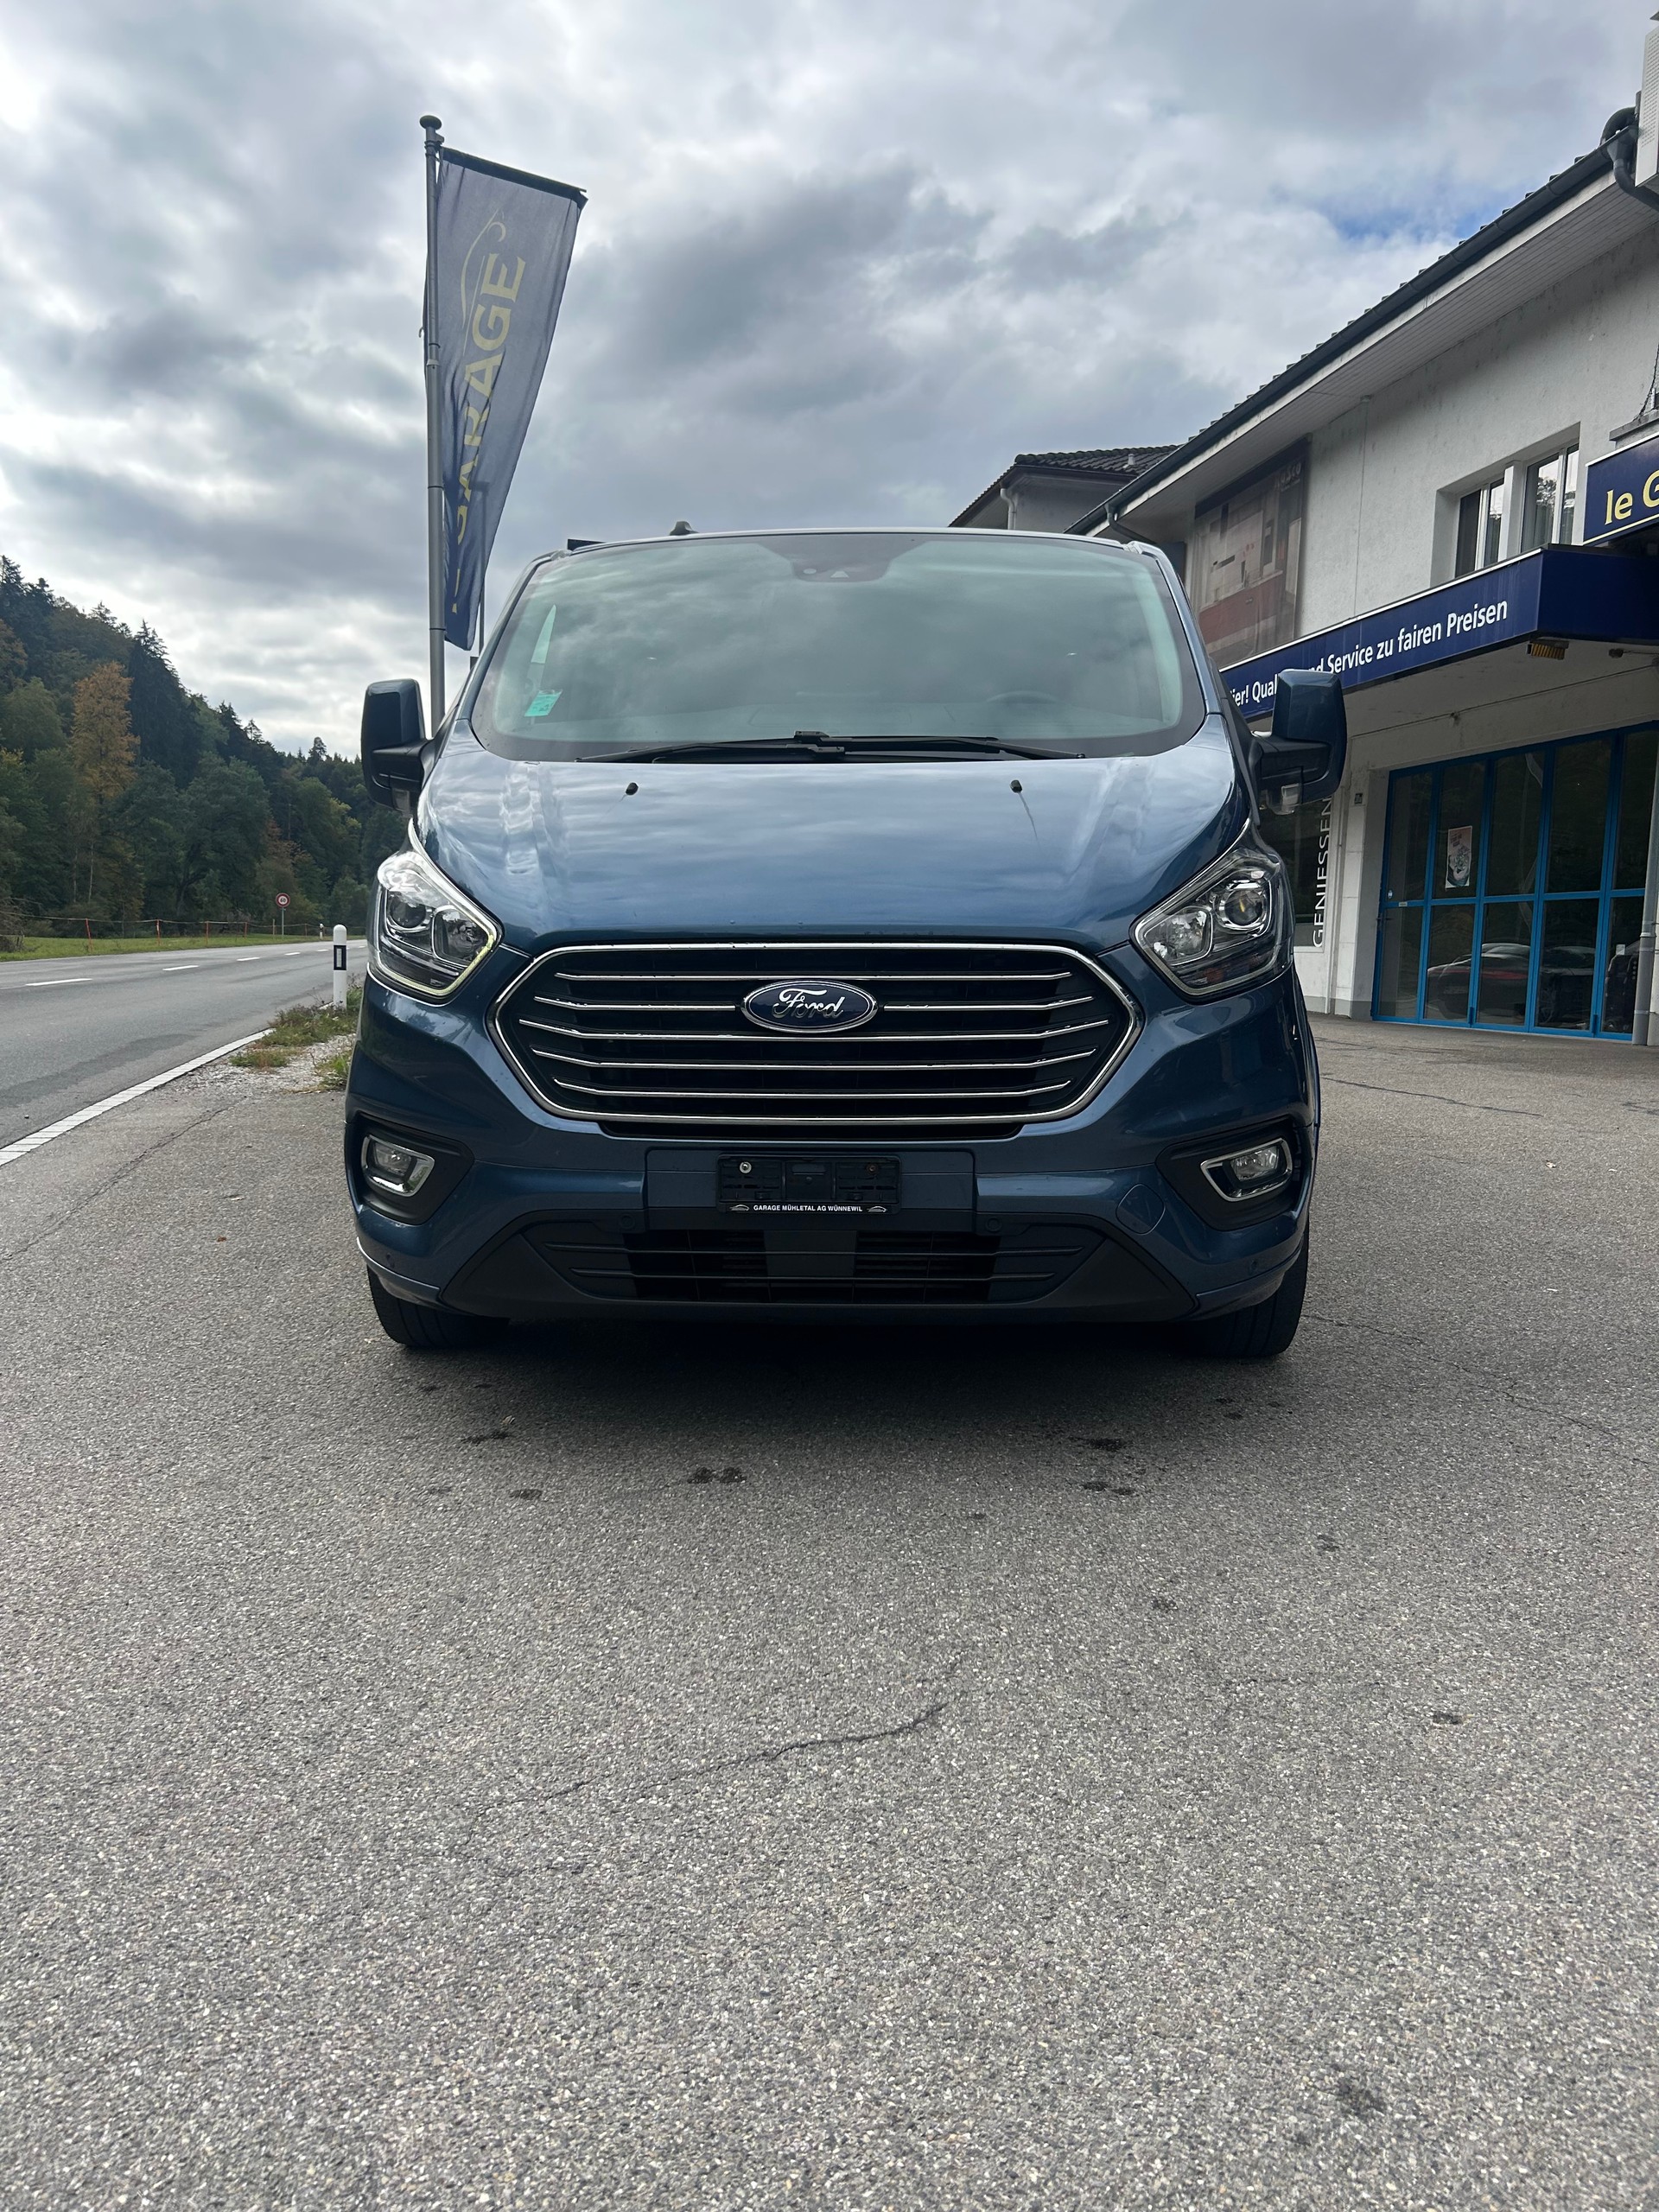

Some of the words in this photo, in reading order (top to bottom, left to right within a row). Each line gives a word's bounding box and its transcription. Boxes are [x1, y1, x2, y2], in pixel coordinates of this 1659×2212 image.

[1605, 490, 1633, 524] le
[1230, 688, 1249, 707] ier!
[1252, 673, 1278, 702] Qual
[1328, 644, 1373, 673] Service
[1376, 638, 1394, 659] zu
[1397, 621, 1441, 654] fairen
[1446, 600, 1507, 638] Preisen
[772, 988, 846, 1019] Ford
[828, 1204, 862, 1212] WÜNNEWIL
